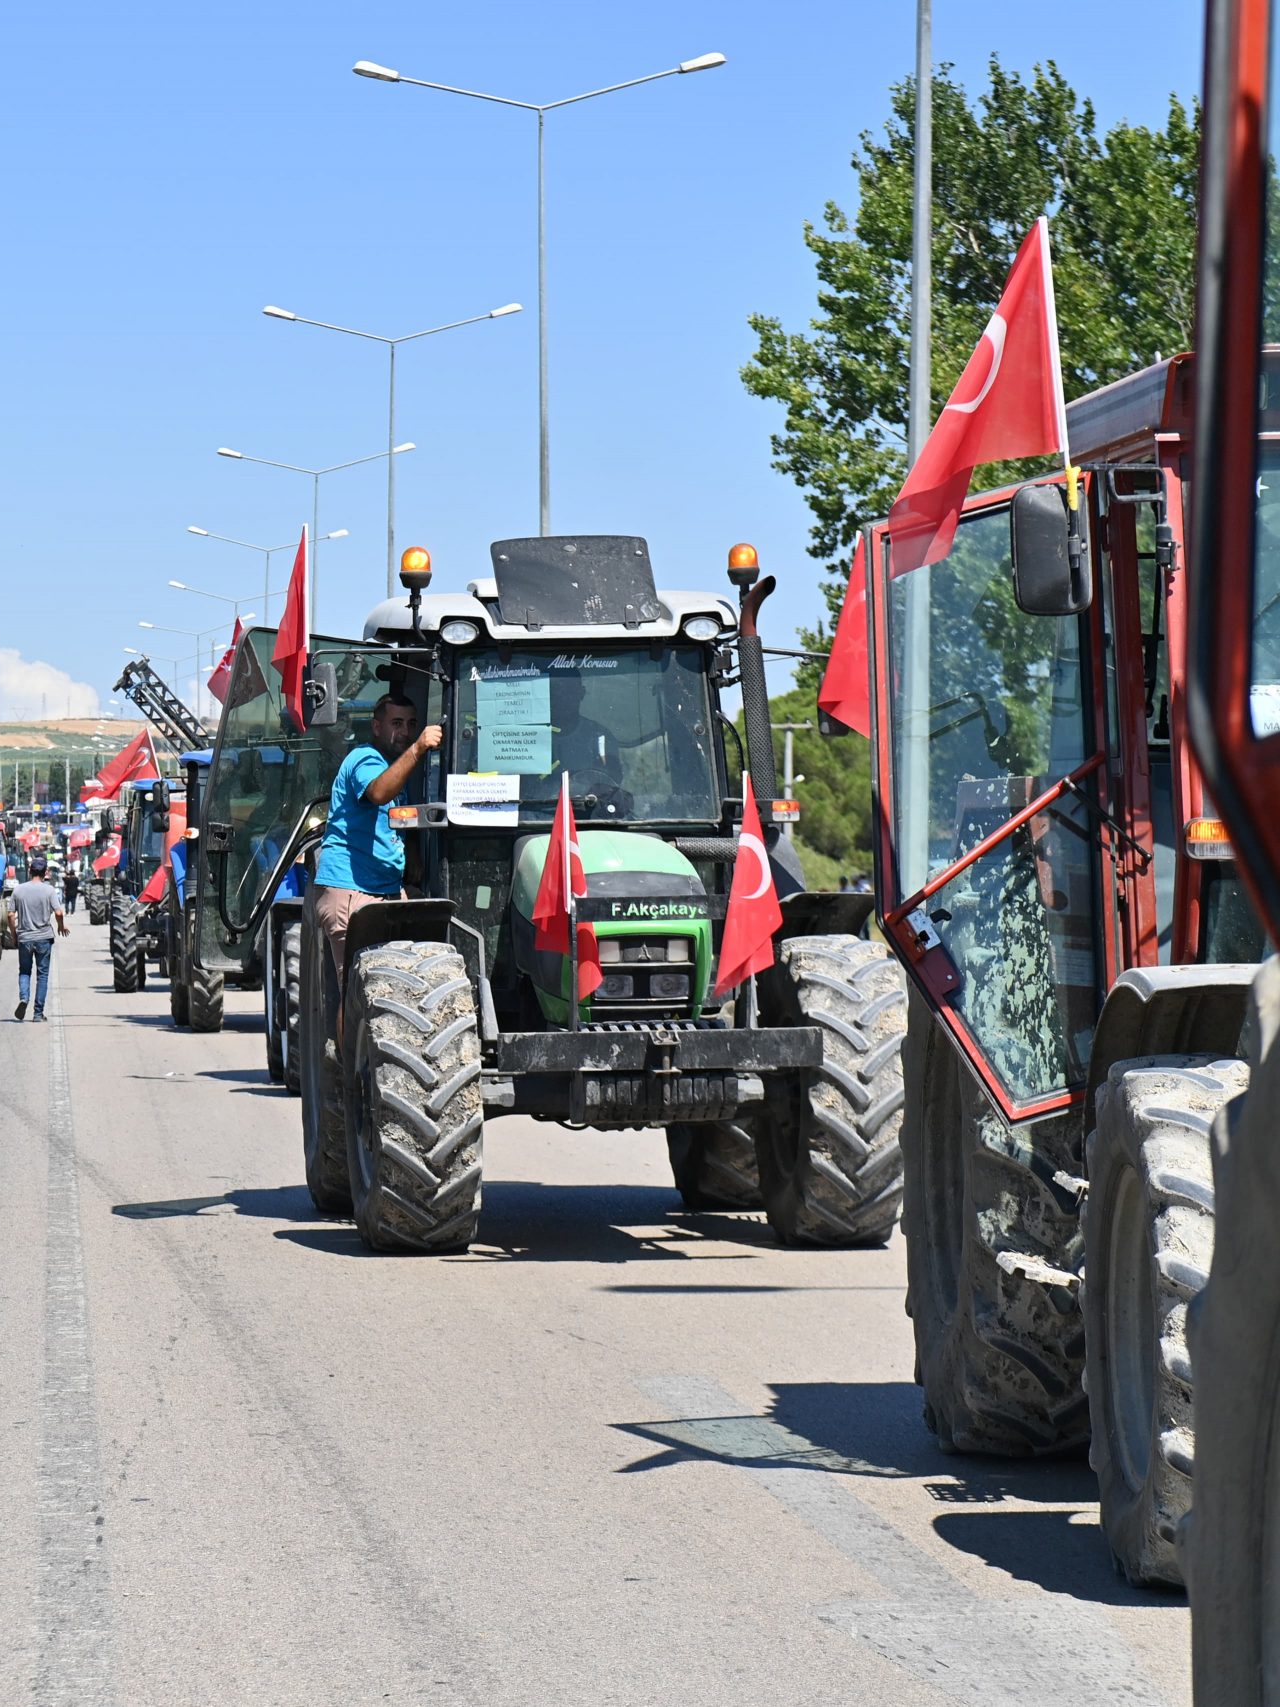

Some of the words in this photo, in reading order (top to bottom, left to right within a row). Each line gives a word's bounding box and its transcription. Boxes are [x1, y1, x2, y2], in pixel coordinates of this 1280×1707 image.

[547, 654, 576, 669] Allah
[577, 654, 619, 669] Korusun
[611, 901, 707, 919] F.Akçakaya
